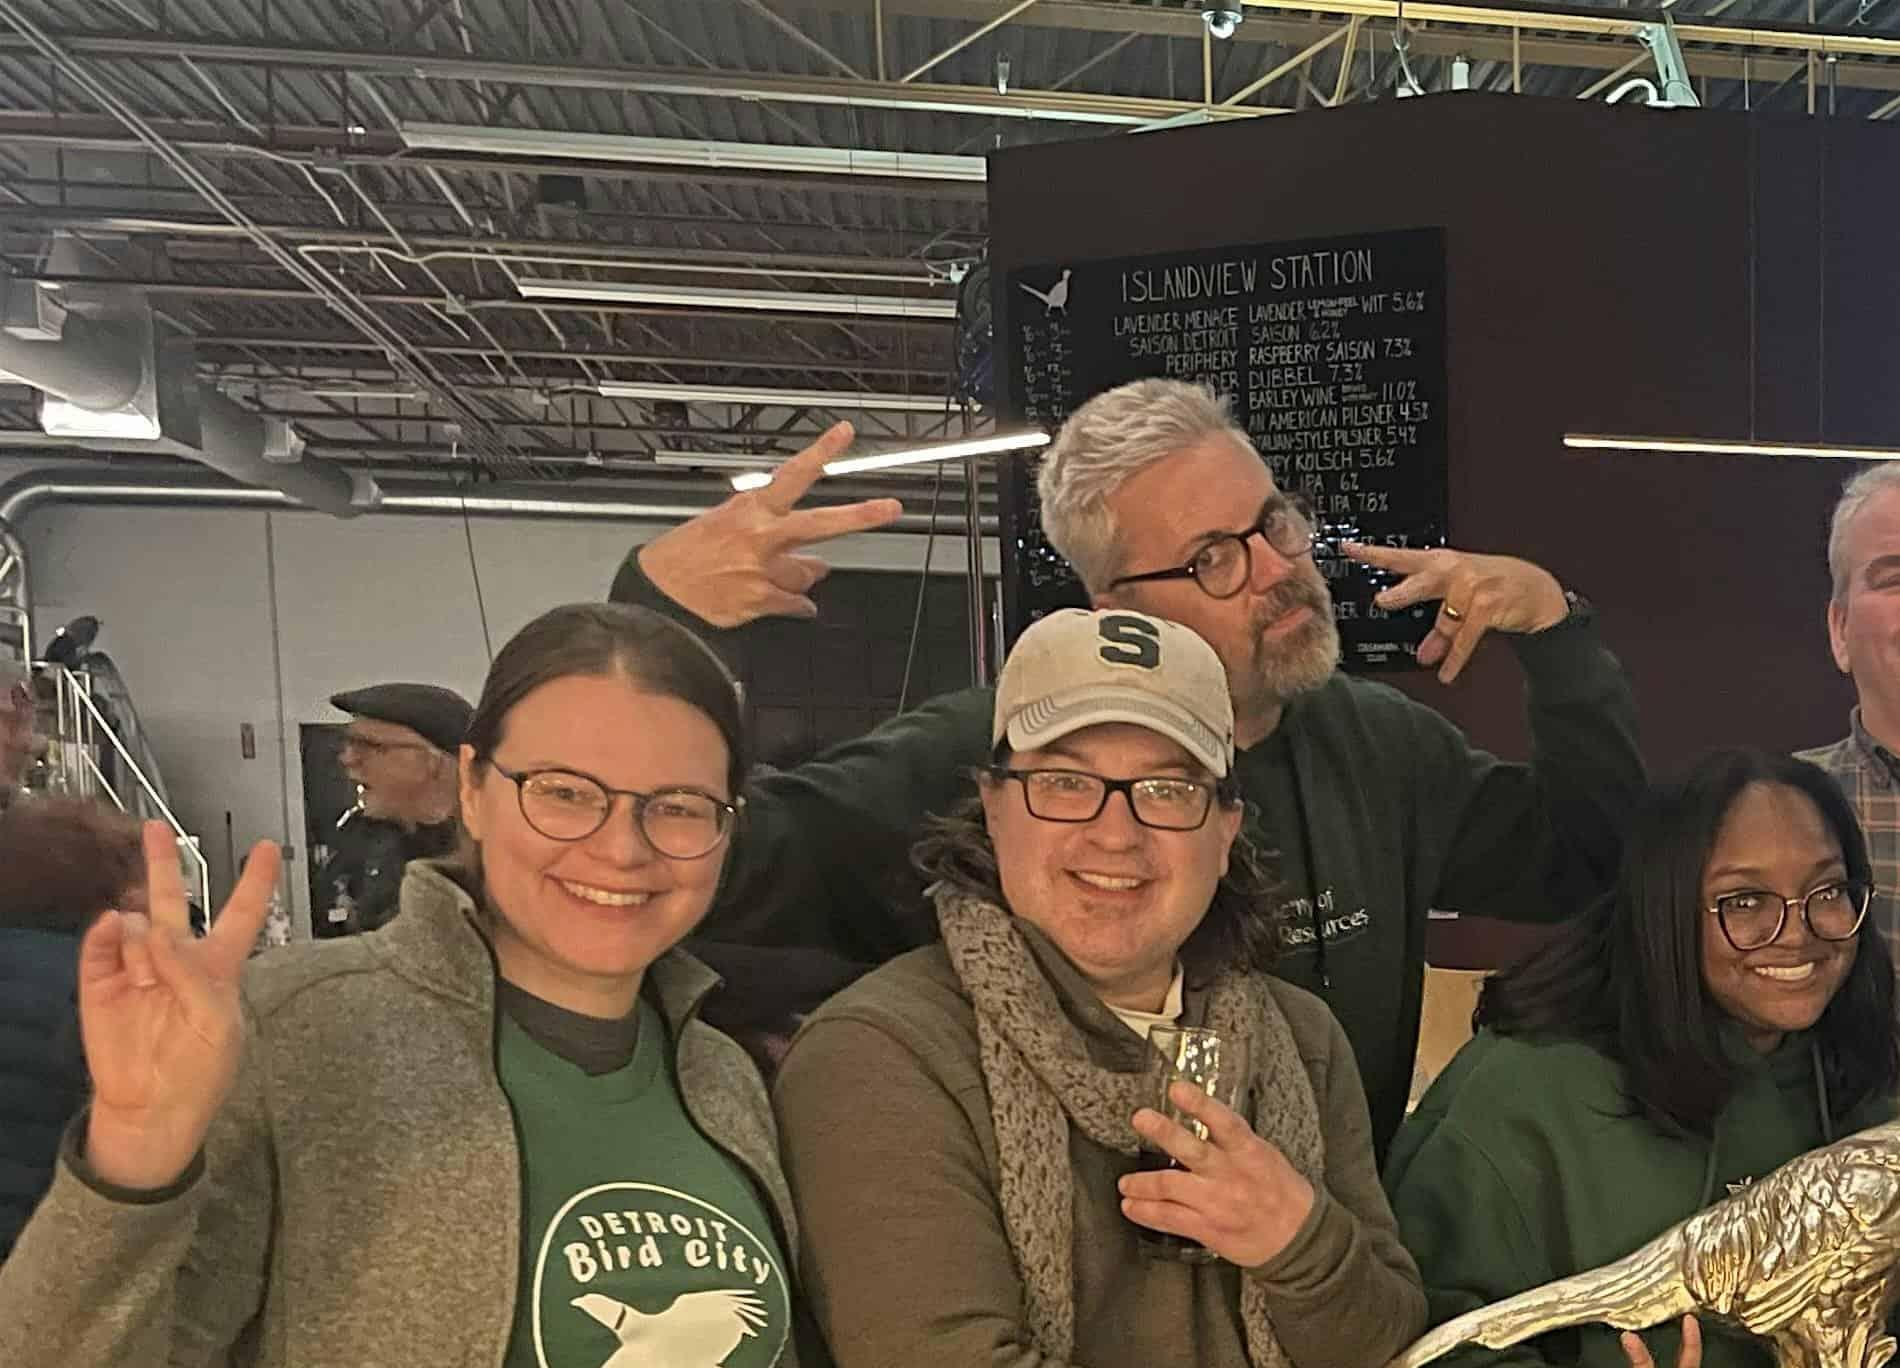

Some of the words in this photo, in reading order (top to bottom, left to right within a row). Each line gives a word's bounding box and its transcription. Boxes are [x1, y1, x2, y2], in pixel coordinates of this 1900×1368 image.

[1121, 258, 1257, 303] ISLANDVIEW
[1270, 249, 1373, 290] STATION
[1113, 312, 1182, 336] LAVENDER
[1184, 307, 1239, 330] MENACE
[1248, 301, 1307, 324] LAVENDER
[1361, 295, 1388, 313] WIT
[1129, 334, 1179, 356] SAISON
[1183, 328, 1238, 351] DETROIT
[1250, 323, 1300, 345] SAISON
[1166, 350, 1239, 375] PERIPHERY
[1248, 343, 1320, 367] RASPBERRY
[1326, 339, 1376, 362] SAISON
[1248, 366, 1320, 390] DUBBEL
[1249, 388, 1298, 411] BARLEY
[1300, 385, 1339, 408] WINE
[1268, 408, 1338, 430] AMERICAN
[1341, 403, 1397, 427] PILSNER
[1340, 471, 1360, 491] 6%
[1330, 495, 1352, 512] IPA
[1098, 613, 1161, 670] S
[578, 1211, 729, 1242] DETROIT
[563, 1236, 663, 1284] Bird
[684, 1239, 770, 1284] City
